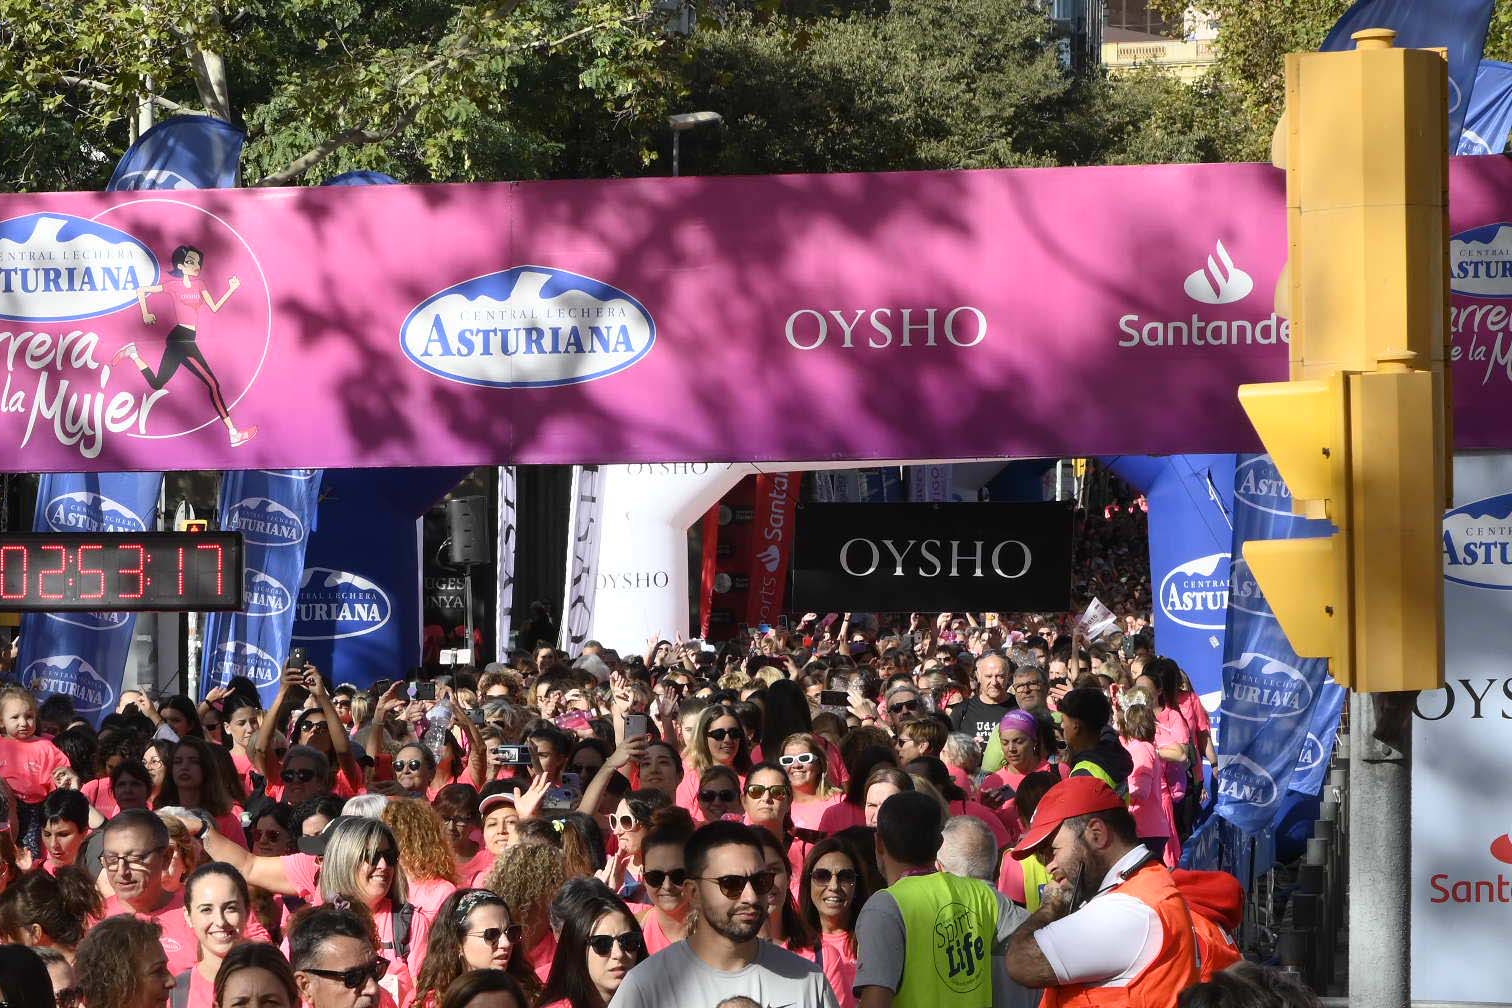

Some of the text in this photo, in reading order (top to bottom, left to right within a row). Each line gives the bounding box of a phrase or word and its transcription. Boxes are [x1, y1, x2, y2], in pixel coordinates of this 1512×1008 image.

[63, 249, 136, 260] LECHERA
[419, 313, 636, 358] ASTURIANA
[459, 306, 627, 322] CENTRAL LECHERA
[784, 306, 988, 350] OYSHO
[1118, 313, 1291, 347] Santande
[0, 373, 26, 413] la
[20, 364, 170, 459] Mujer
[228, 511, 298, 540] ASTURIANA
[0, 544, 224, 599] 02:53:17
[839, 537, 1034, 580] OYSHO
[945, 931, 985, 978] Life
